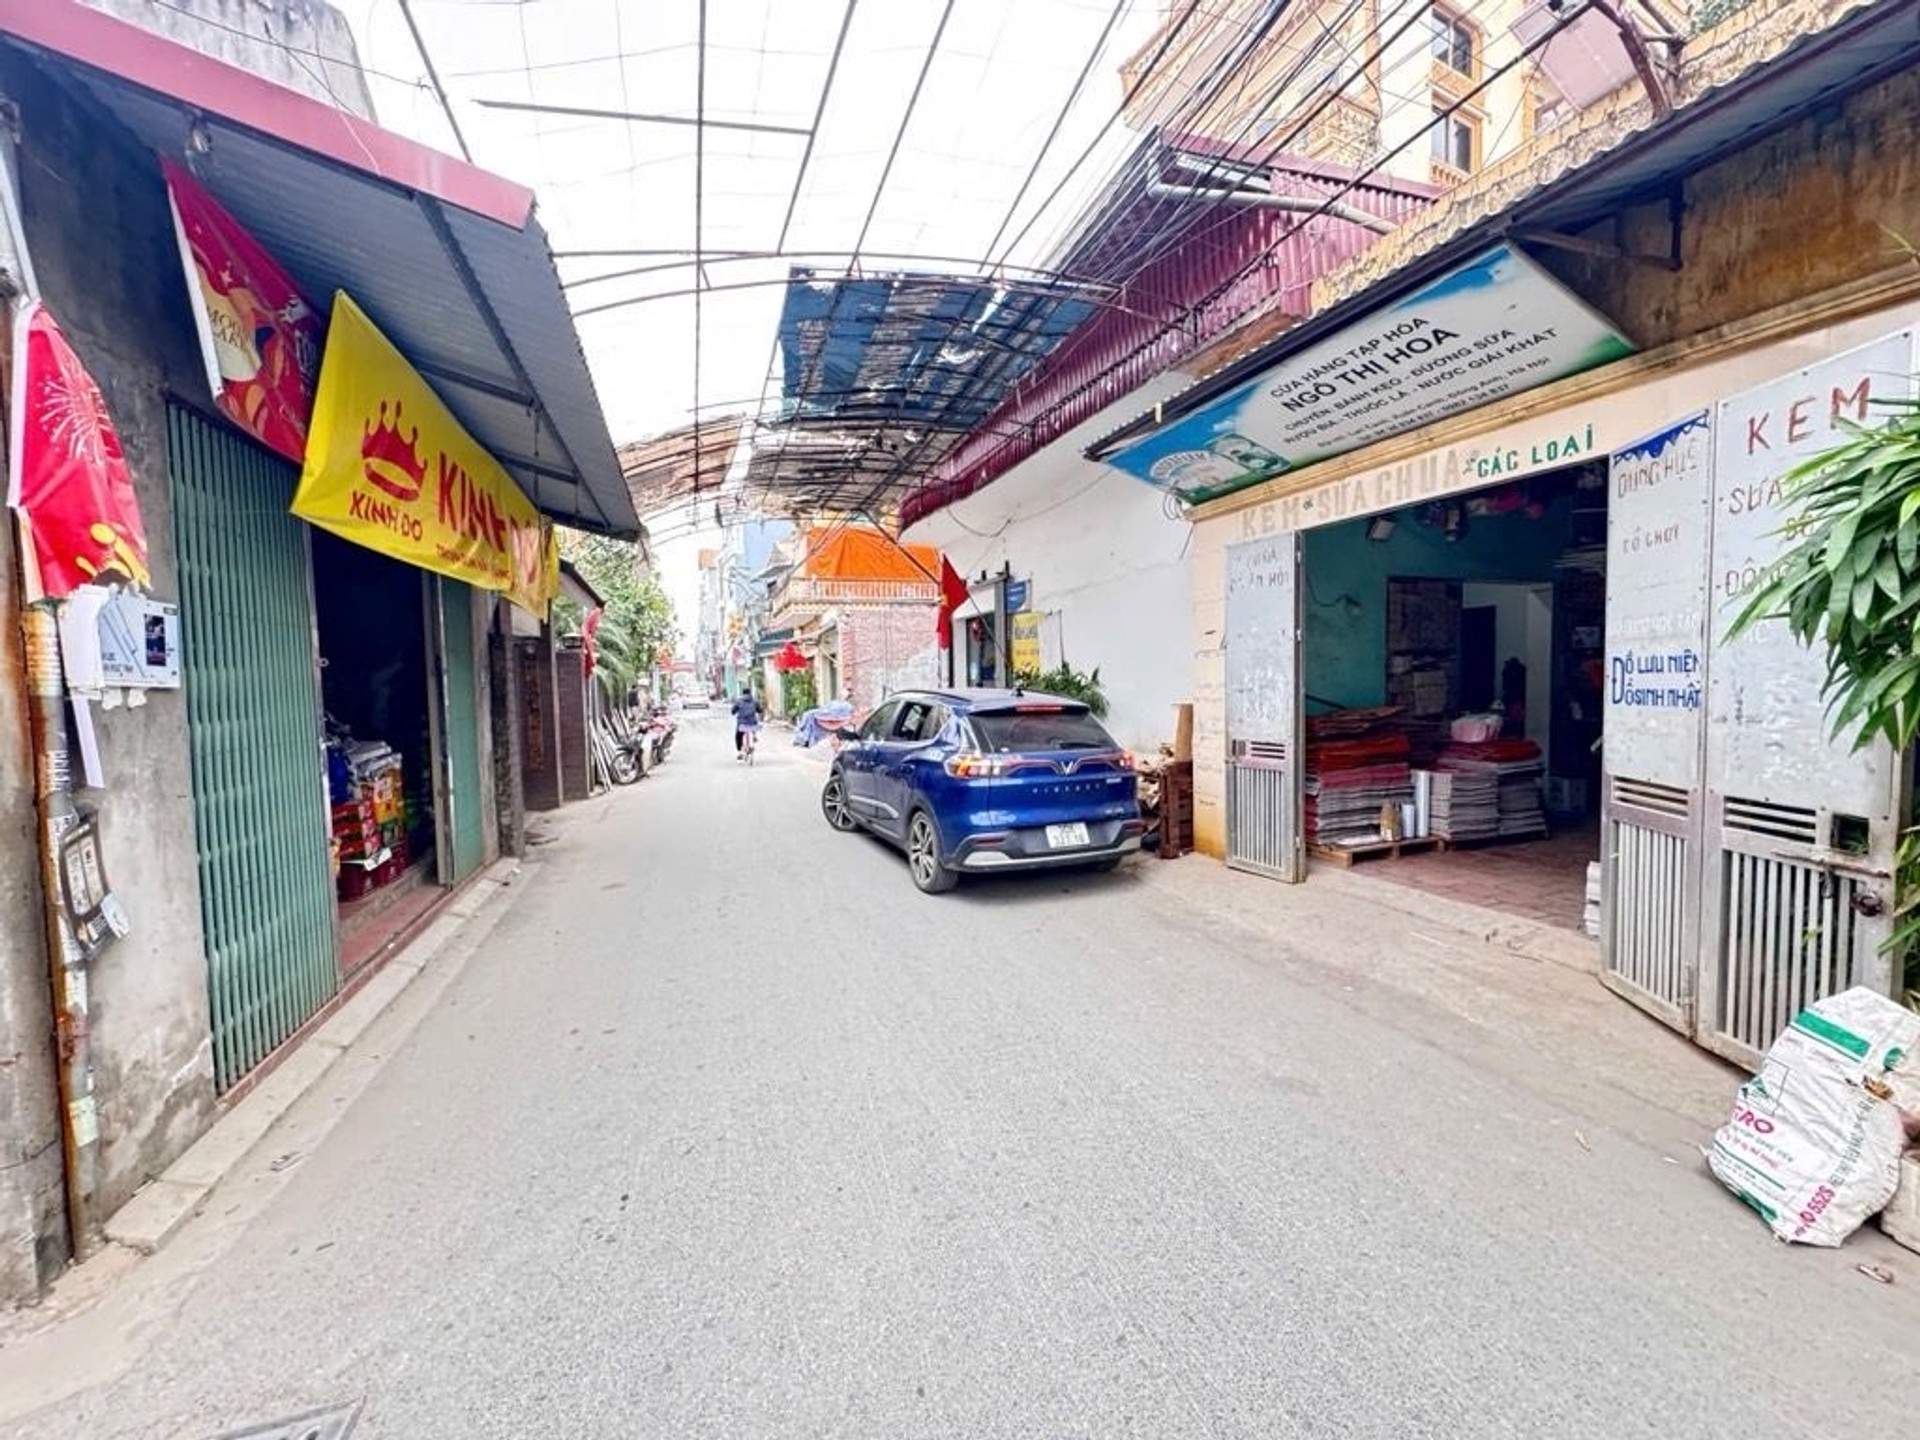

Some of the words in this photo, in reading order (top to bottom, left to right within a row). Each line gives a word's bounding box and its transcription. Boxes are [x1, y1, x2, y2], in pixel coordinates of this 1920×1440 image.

[1281, 381, 1336, 412] NGÔ
[1334, 360, 1390, 385] THỊ
[1383, 328, 1460, 364] HOA
[1302, 356, 1347, 381] HÀNG
[1747, 377, 1872, 455] KEM
[1242, 497, 1299, 538] KEM
[1477, 446, 1519, 477] CÁC
